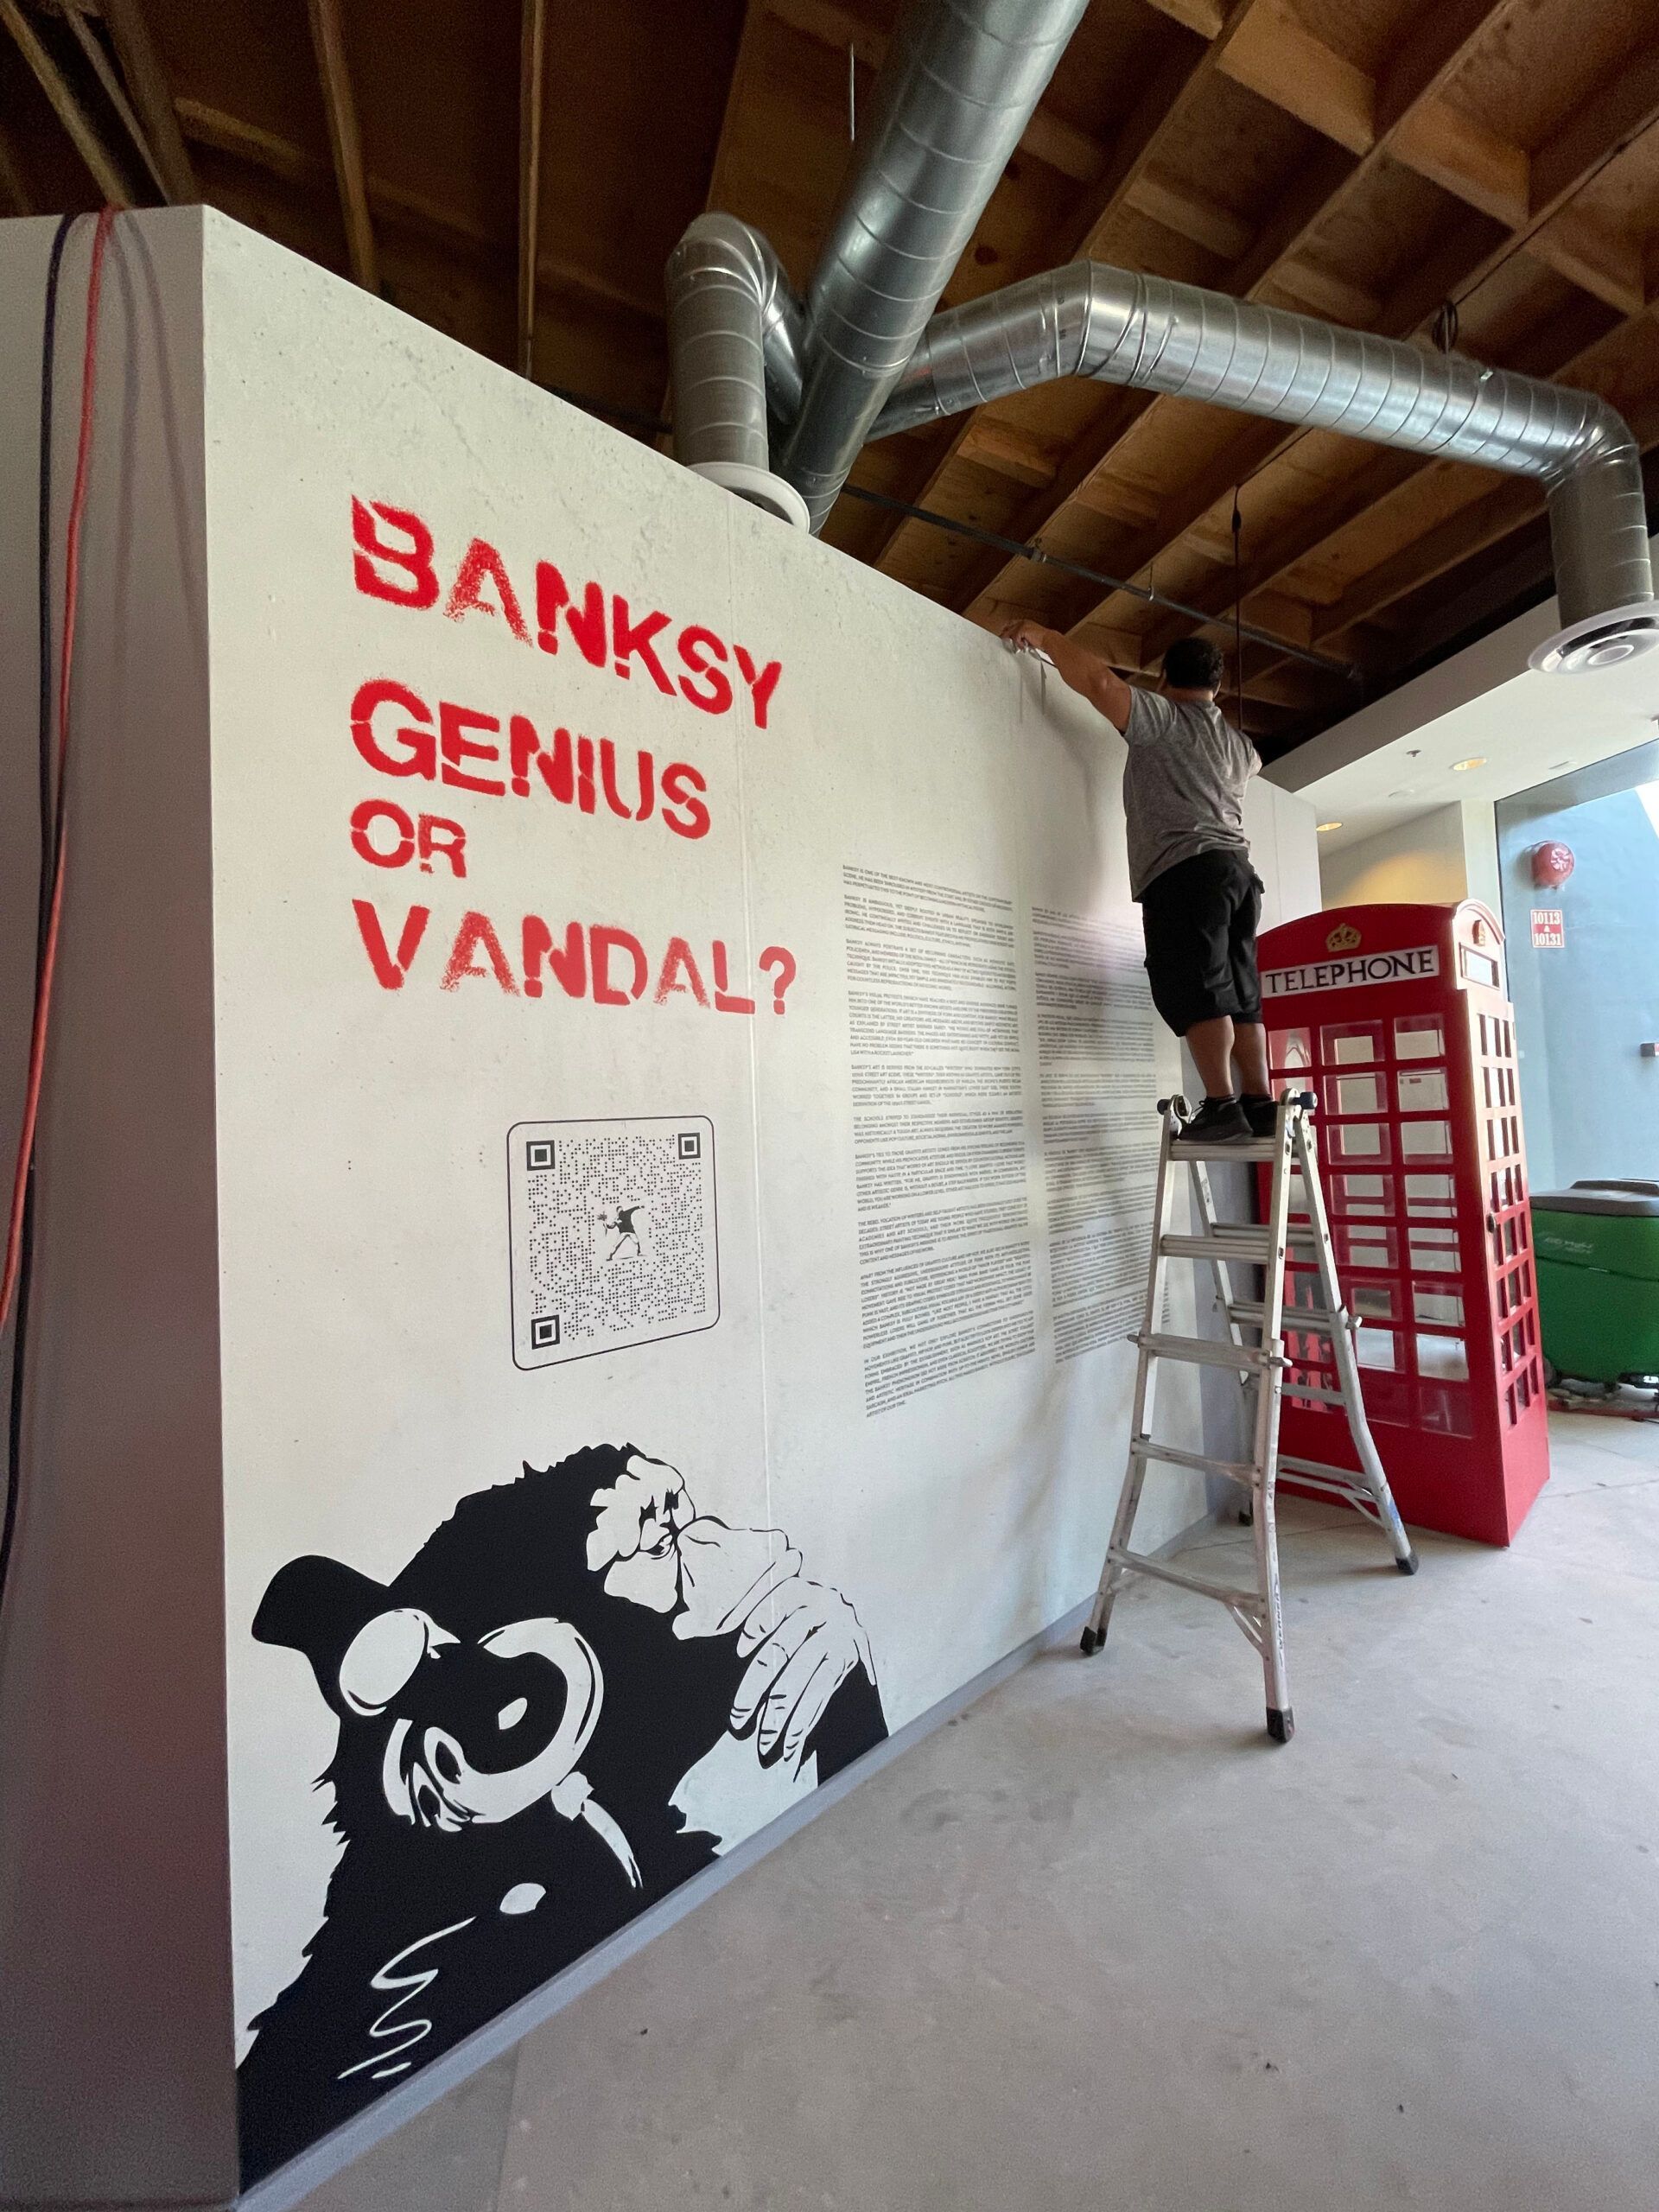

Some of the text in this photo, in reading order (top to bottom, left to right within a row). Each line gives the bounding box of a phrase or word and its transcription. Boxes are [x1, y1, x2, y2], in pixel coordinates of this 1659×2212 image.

[351, 494, 782, 728] BANKSY
[351, 678, 711, 839] GENIUS
[350, 798, 467, 878] OR
[352, 899, 797, 1015] VANDAL?
[1533, 912, 1560, 925] 10113
[1534, 933, 1562, 946] 10131
[1266, 950, 1434, 993] TELEPHONE
